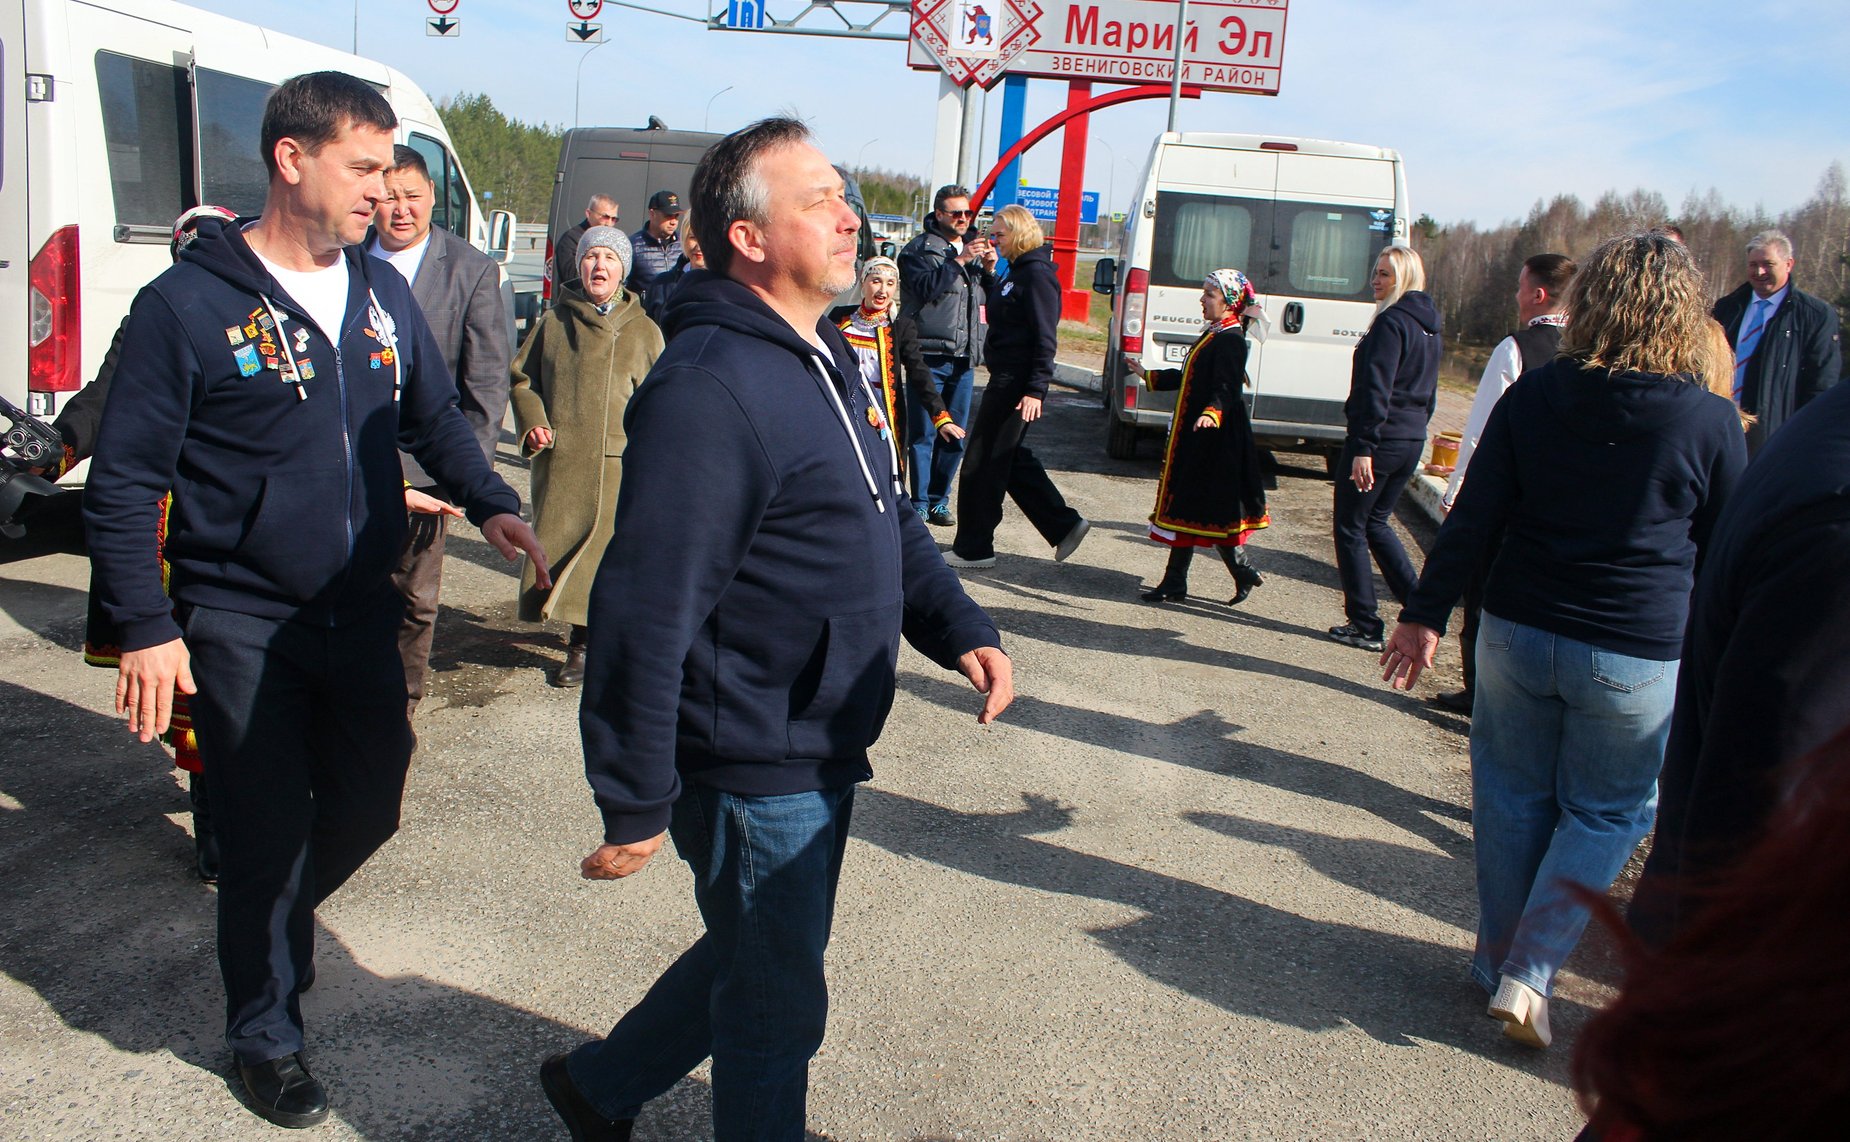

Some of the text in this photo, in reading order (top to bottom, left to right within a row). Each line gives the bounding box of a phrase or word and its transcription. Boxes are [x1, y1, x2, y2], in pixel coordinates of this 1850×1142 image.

[1065, 4, 1273, 58] Марий Эл
[1052, 56, 1265, 86] ЗВЕНИГОВСКИЙ РАЙОН
[1332, 329, 1365, 338] BOXE
